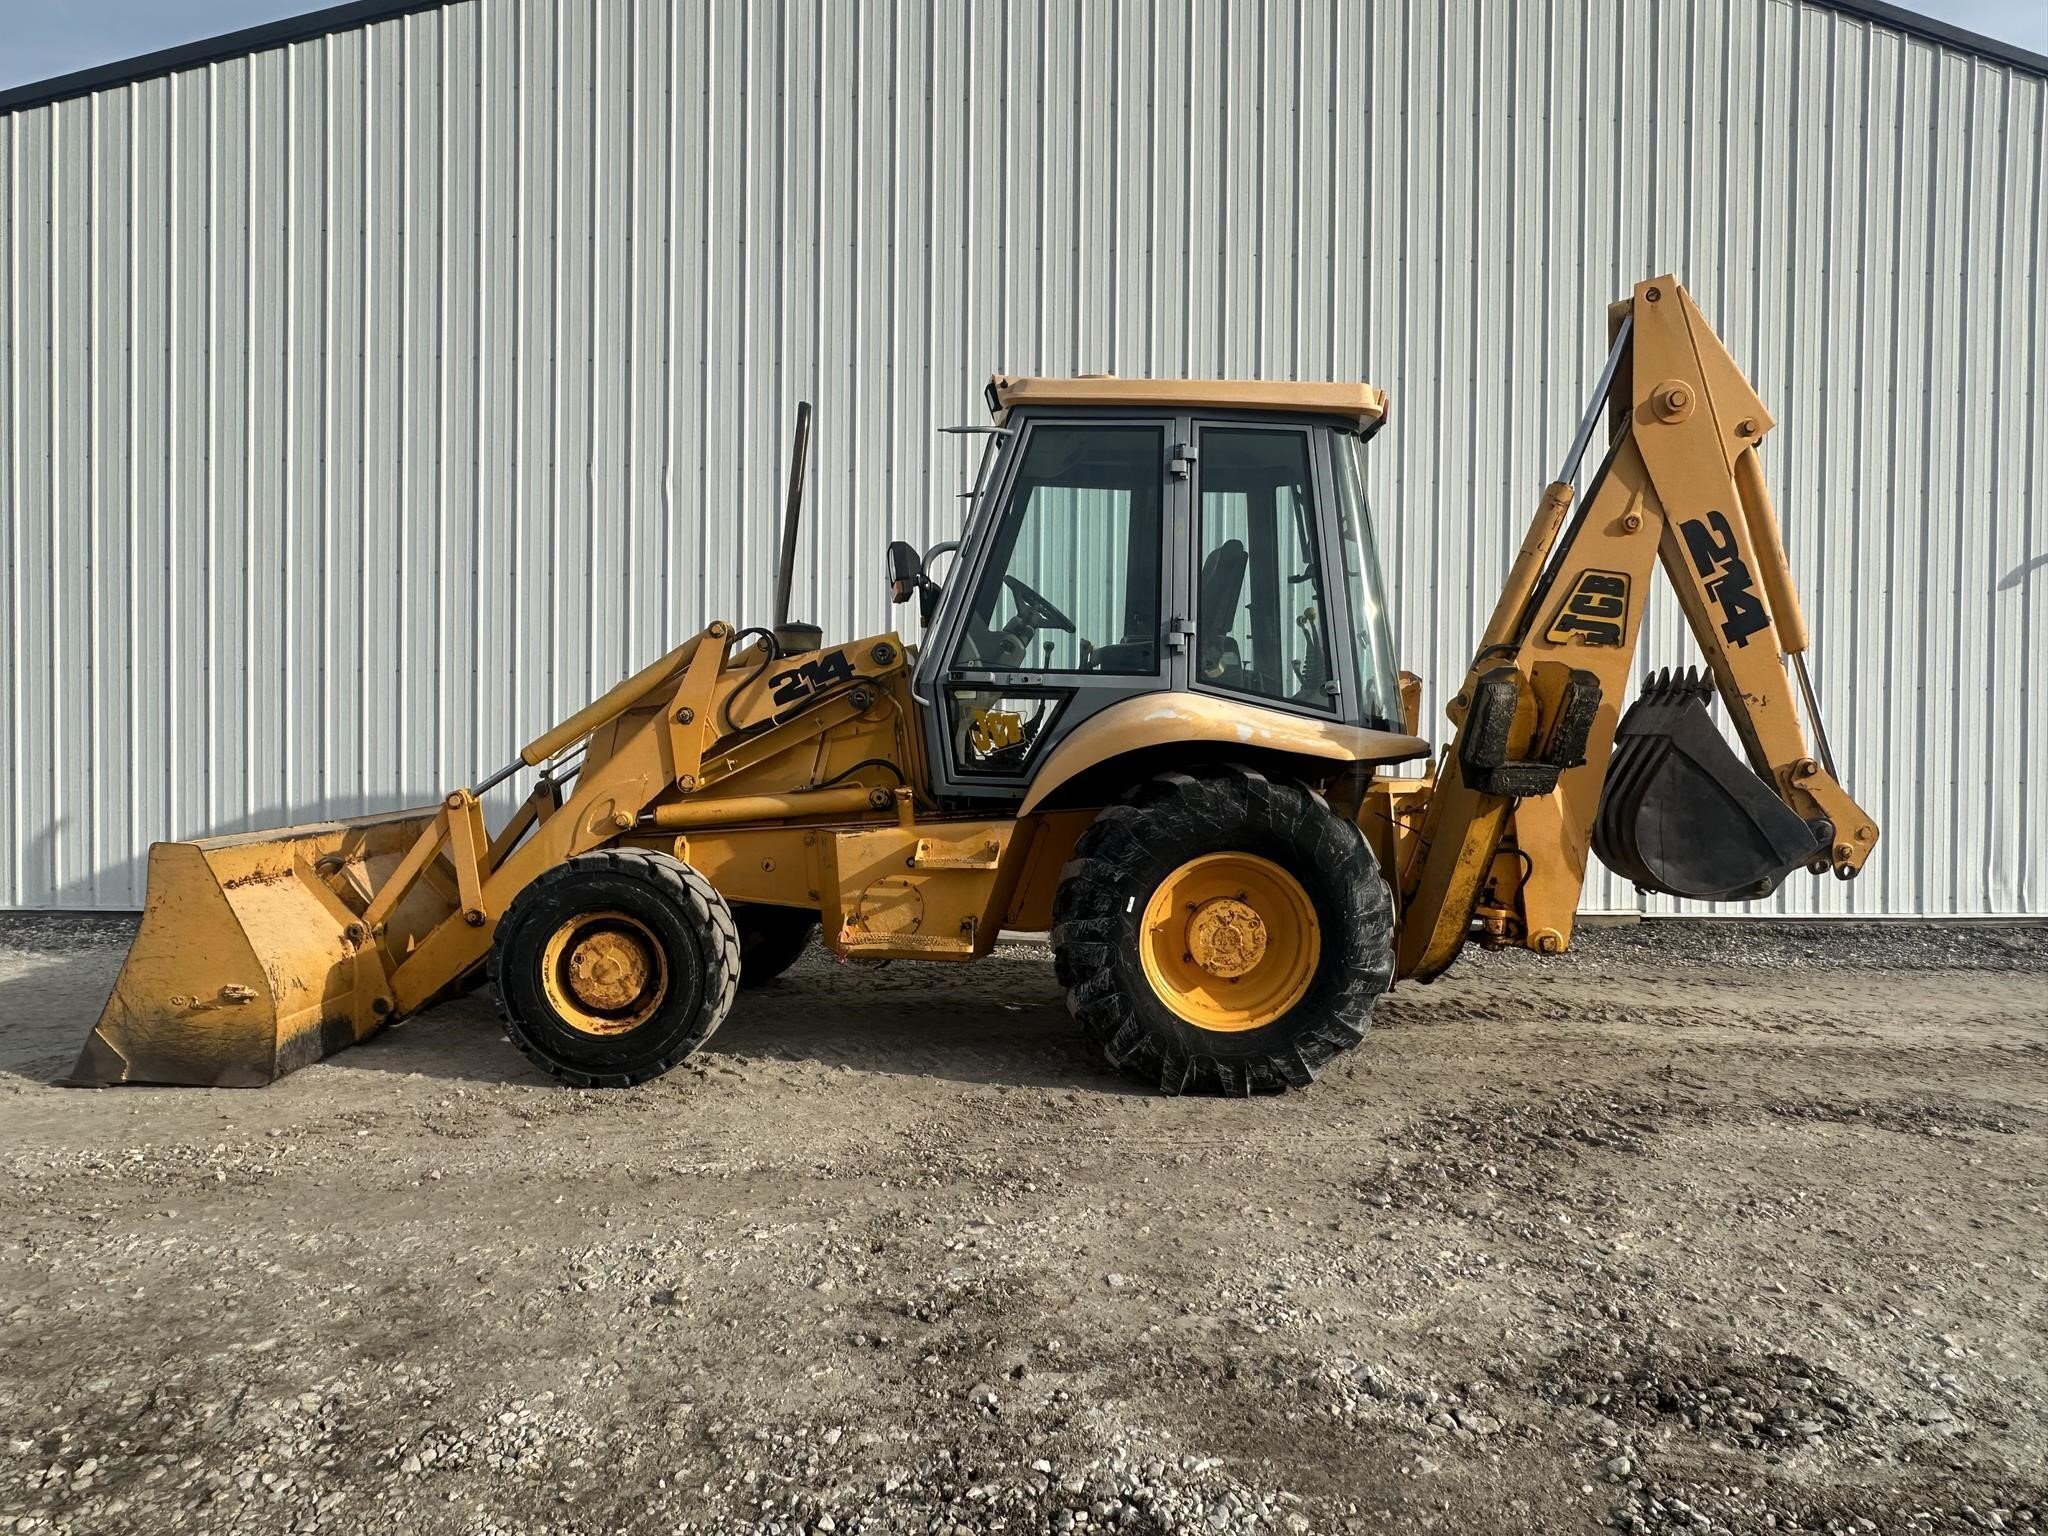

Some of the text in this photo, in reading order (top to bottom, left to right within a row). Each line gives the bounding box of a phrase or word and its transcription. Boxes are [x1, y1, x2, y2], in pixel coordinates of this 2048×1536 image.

[1555, 575, 1625, 646] JCB
[1679, 511, 1771, 648] 214
[769, 650, 855, 706] 214
